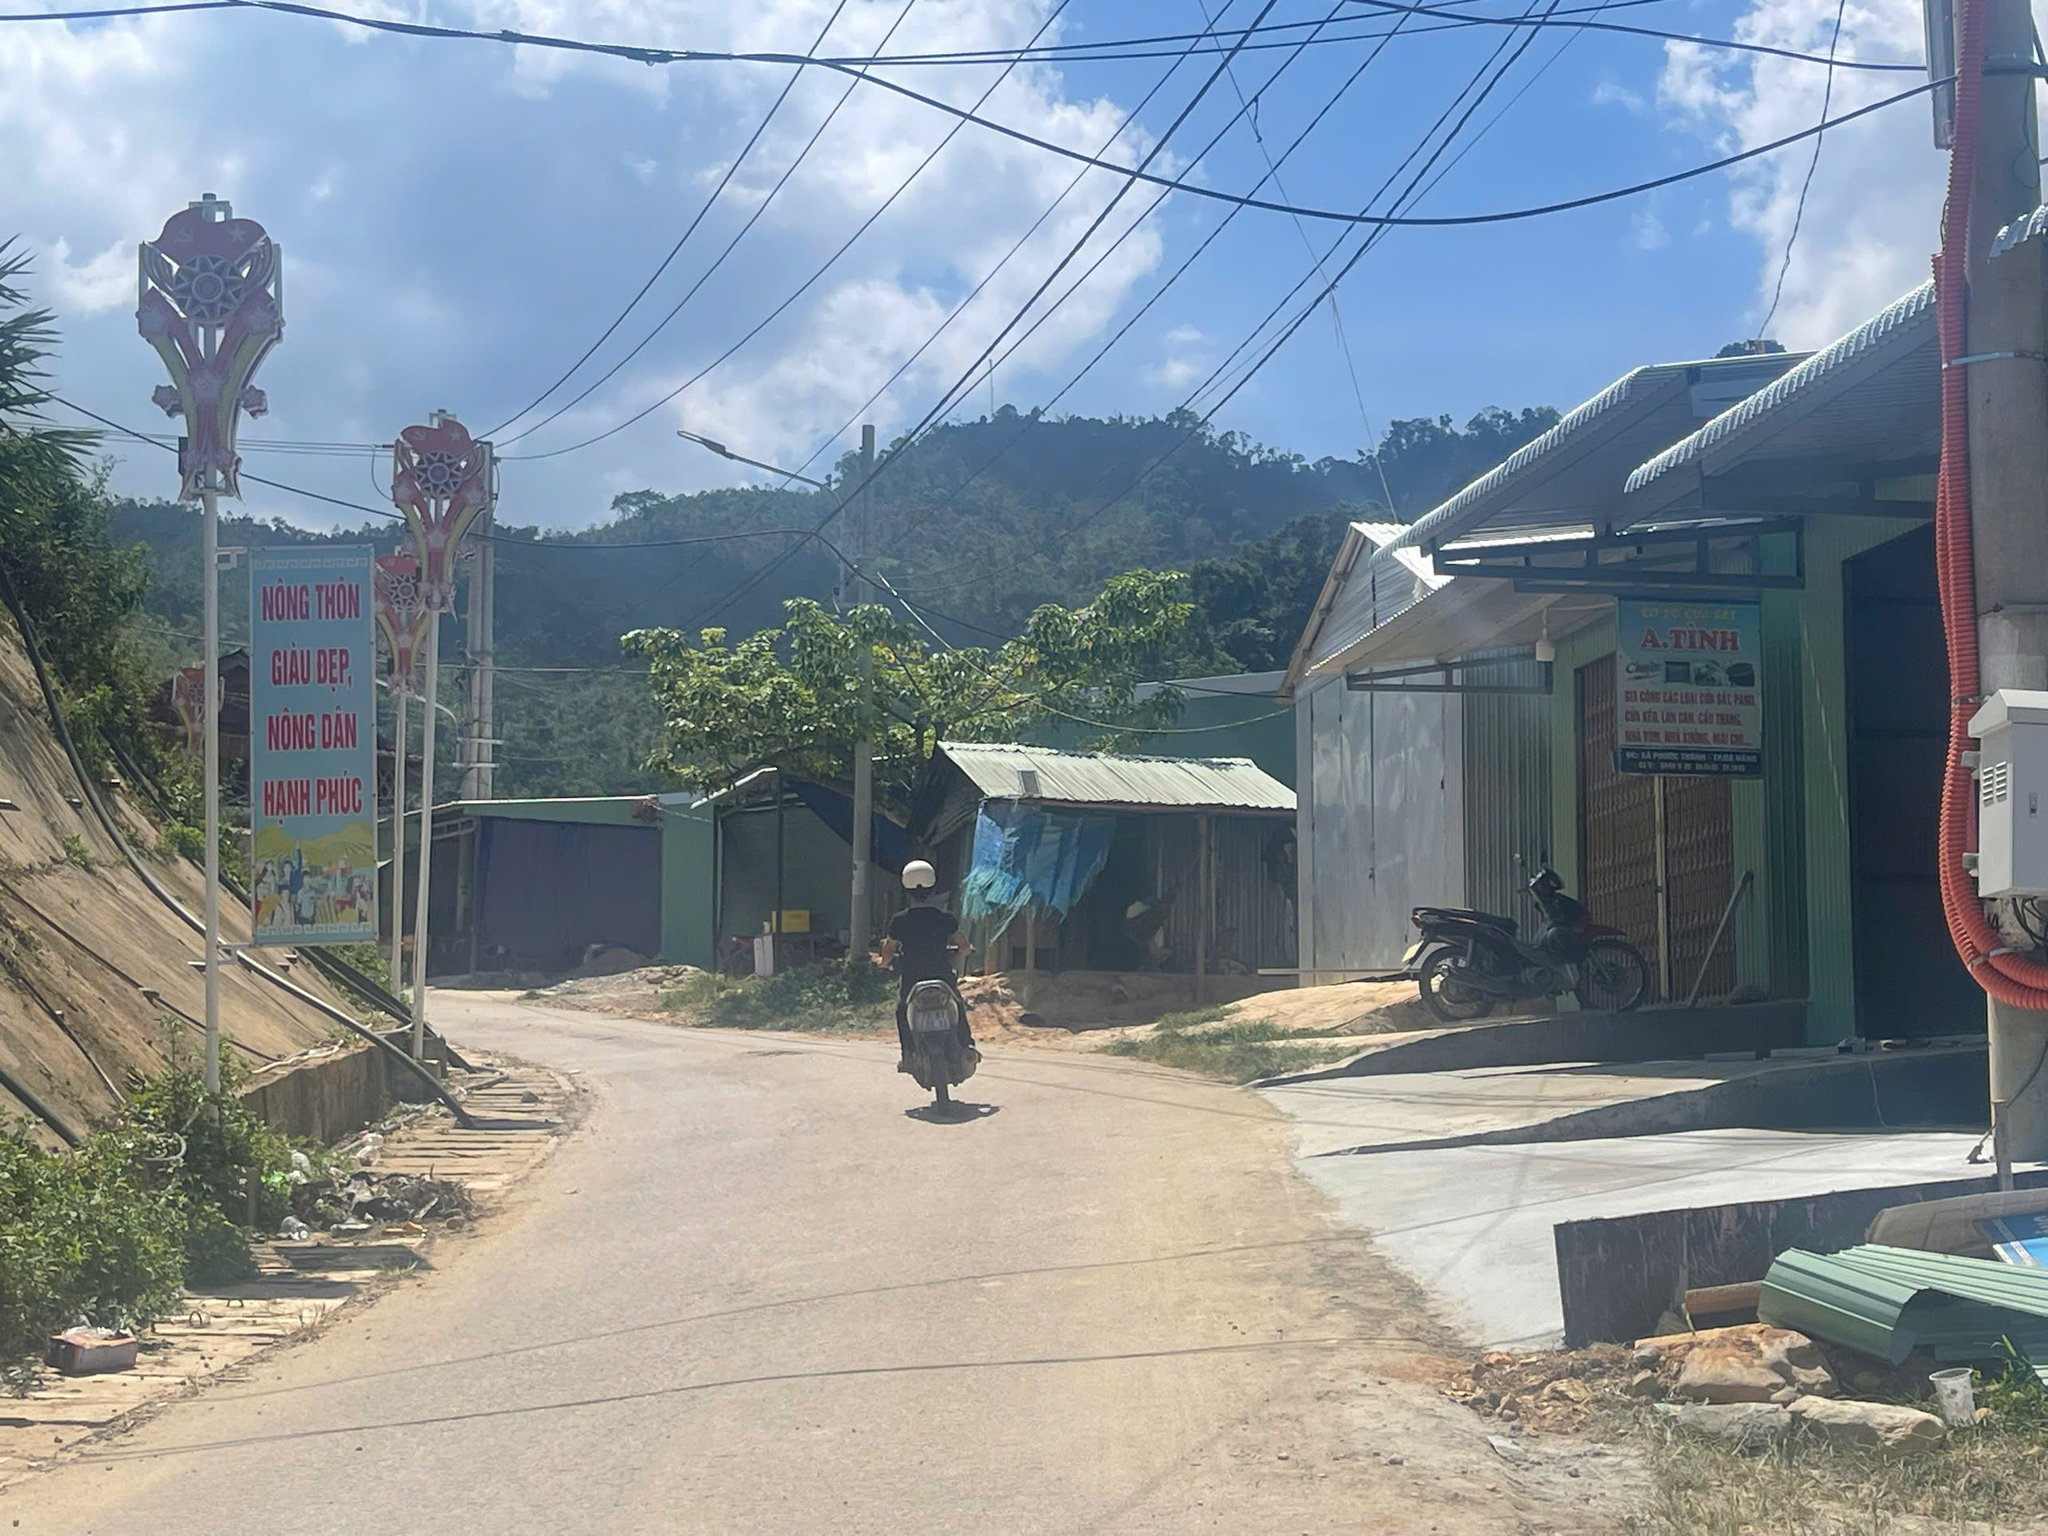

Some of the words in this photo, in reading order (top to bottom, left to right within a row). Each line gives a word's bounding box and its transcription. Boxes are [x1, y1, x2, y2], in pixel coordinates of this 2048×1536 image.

[262, 577, 310, 621] NÔNG
[315, 575, 360, 620] THÔN
[271, 643, 312, 687] GIÀU
[316, 647, 352, 693] ĐẸP,
[267, 707, 316, 751] NÔNG
[321, 703, 358, 750] DÂN
[263, 779, 311, 825] HẠNH
[316, 768, 363, 816] PHÚC
